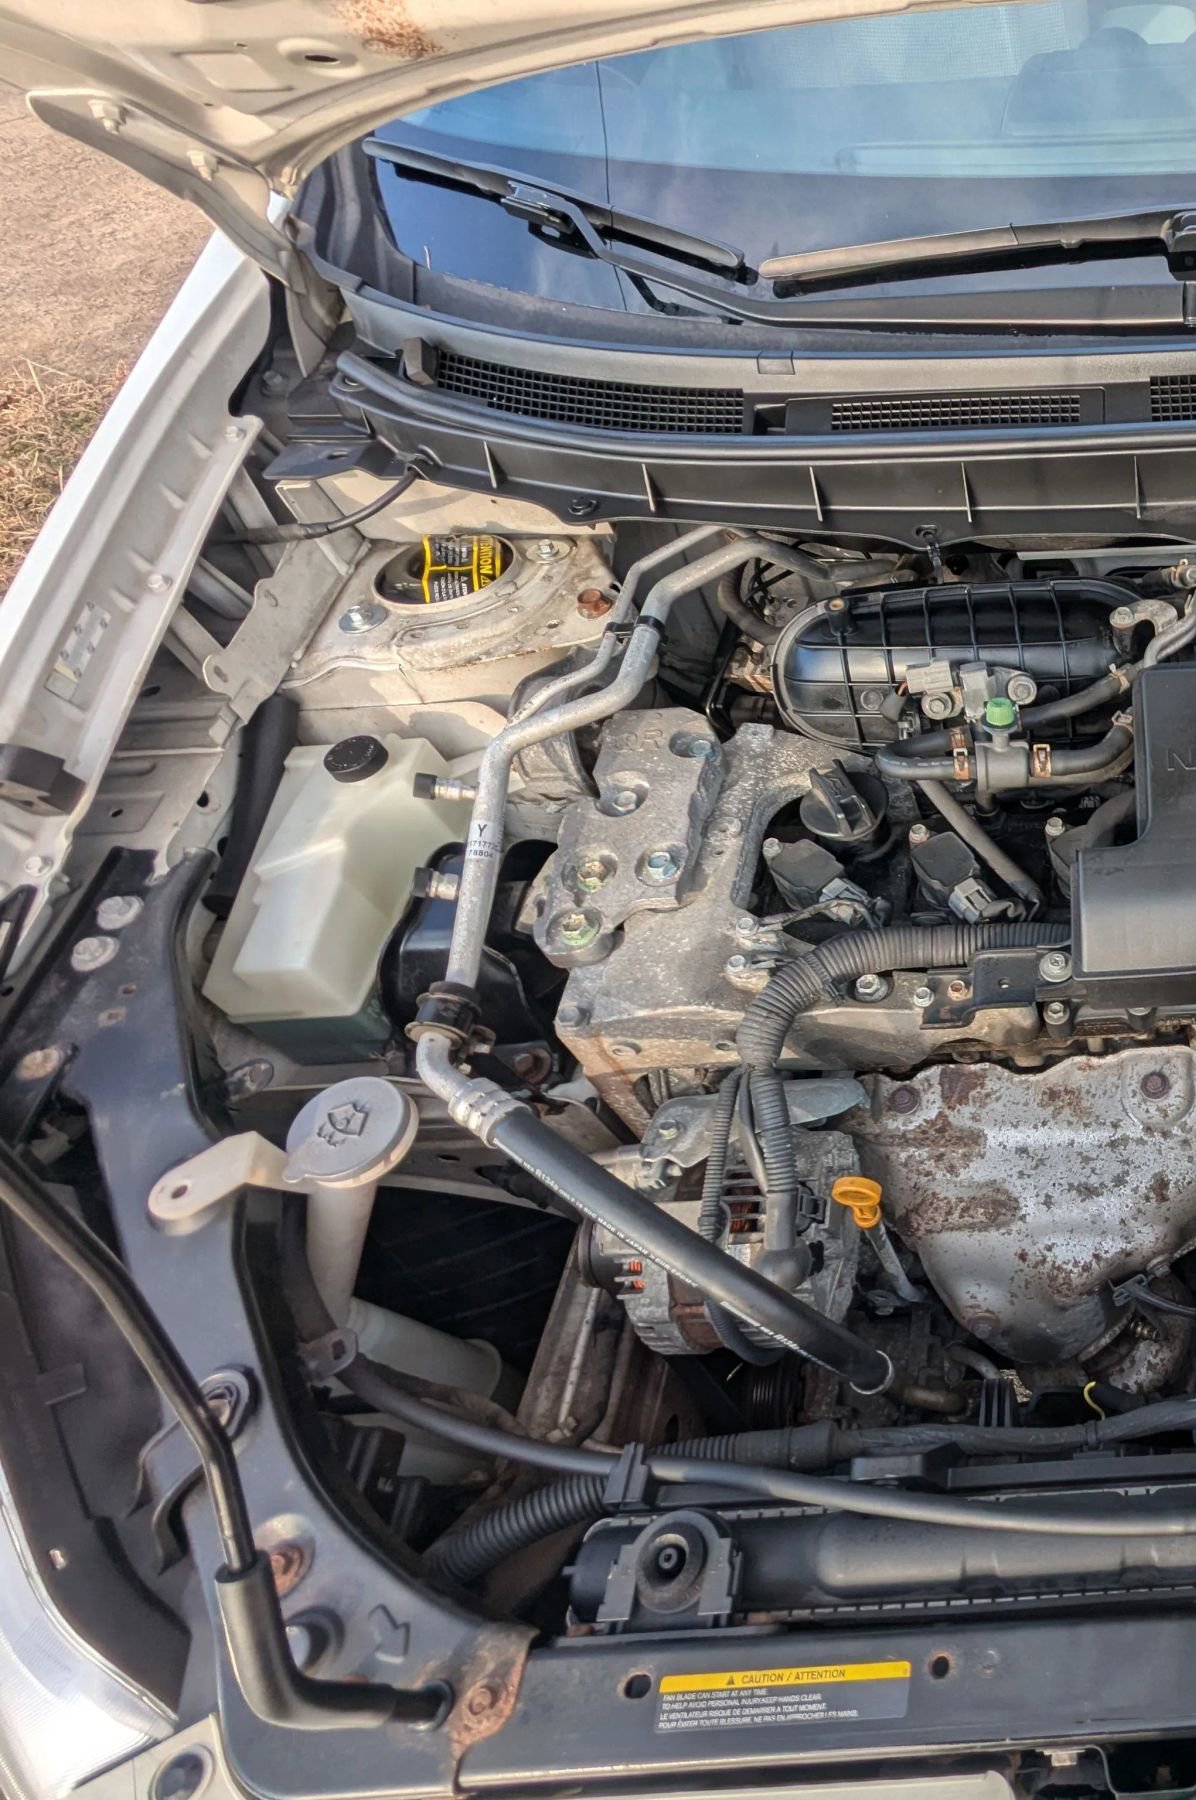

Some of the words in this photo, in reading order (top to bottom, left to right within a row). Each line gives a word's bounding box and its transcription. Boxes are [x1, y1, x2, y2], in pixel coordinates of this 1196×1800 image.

[478, 824, 487, 837] Y
[598, 1217, 616, 1232] MADE
[625, 1237, 648, 1255] JAPAN
[741, 1672, 784, 1684] CAUTION
[794, 1669, 846, 1681] ATTENTION
[676, 1693, 696, 1701] BLADE
[698, 1692, 710, 1700] CAN
[711, 1691, 730, 1699] START
[671, 1702, 688, 1710] HELP
[708, 1699, 740, 1708] PERSONAL
[669, 1710, 708, 1721] VENTILATEUR
[709, 1709, 732, 1717] RISQUE
[782, 1704, 798, 1713] TOUT
[659, 1721, 677, 1729] POUR
[700, 1718, 719, 1727] TOUTE
